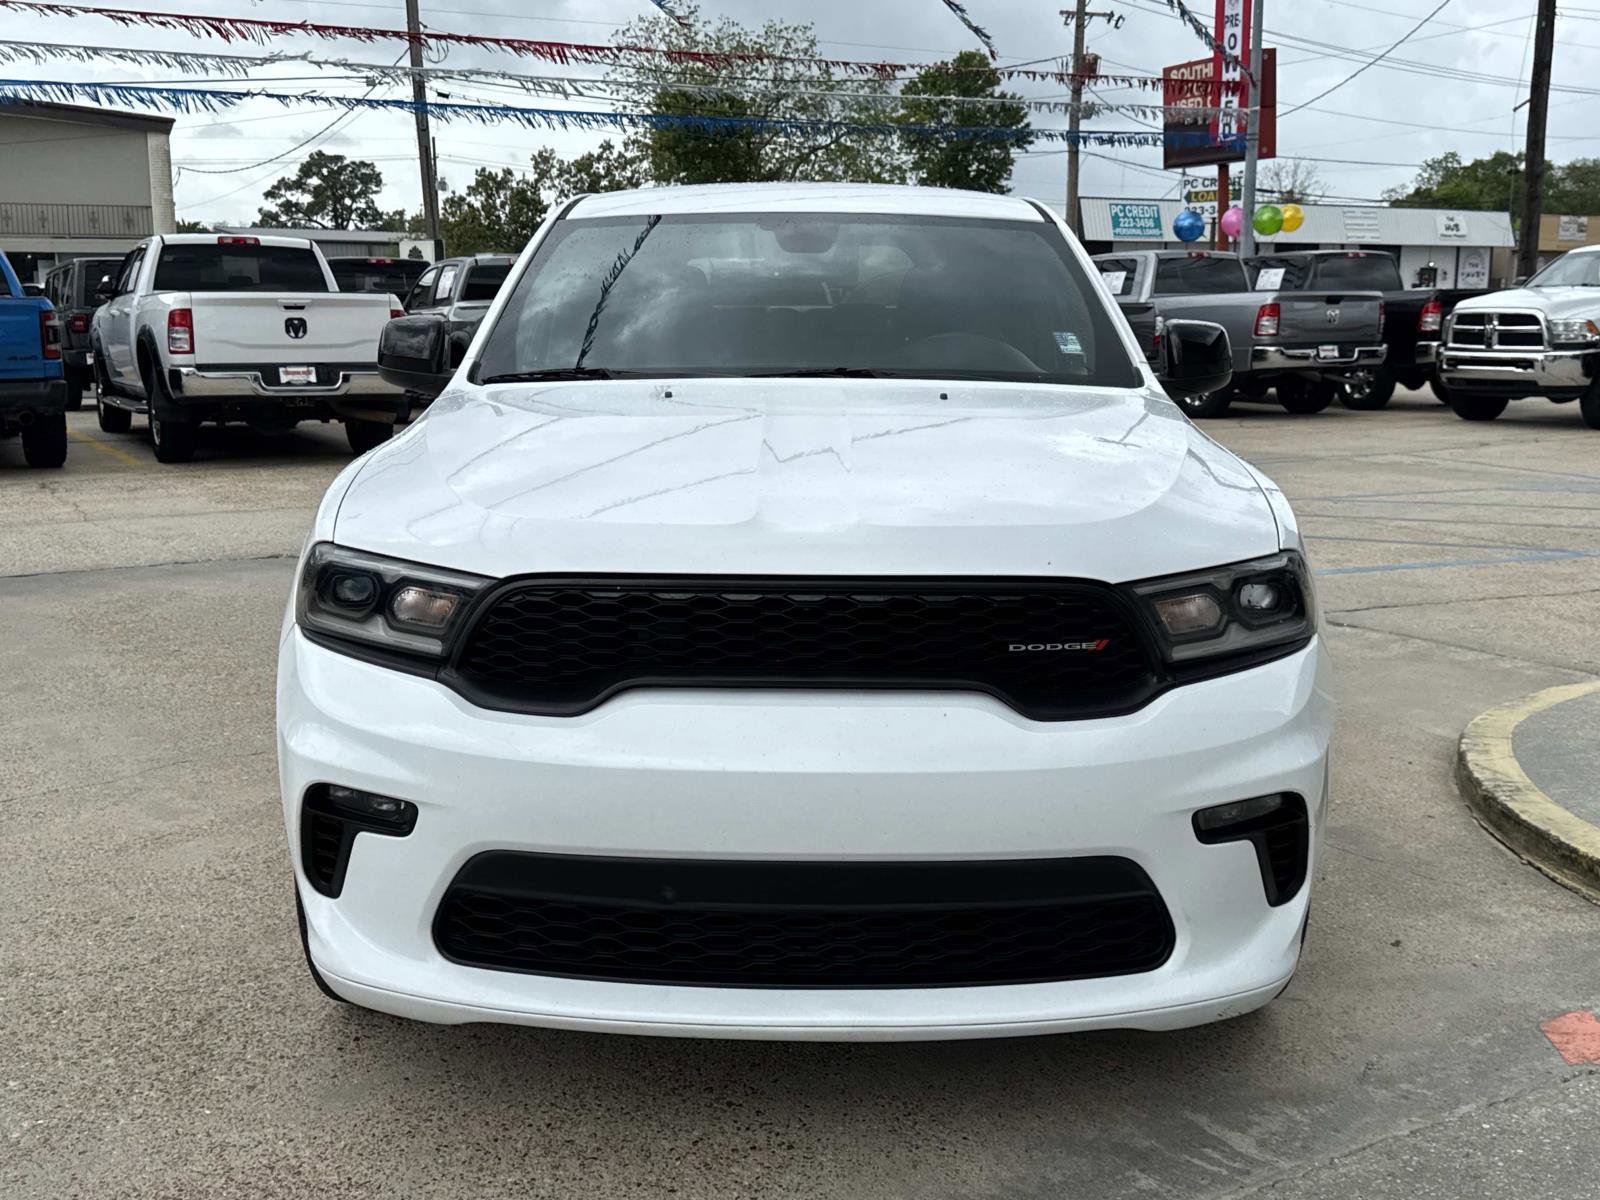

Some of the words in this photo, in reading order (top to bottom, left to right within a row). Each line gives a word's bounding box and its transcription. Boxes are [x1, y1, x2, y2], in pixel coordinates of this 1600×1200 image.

[1183, 179, 1199, 190] PC
[1190, 190, 1233, 202] LOAS
[1110, 204, 1125, 217] PC
[1125, 204, 1159, 219] CREDIT
[1008, 641, 1097, 652] DODGE
